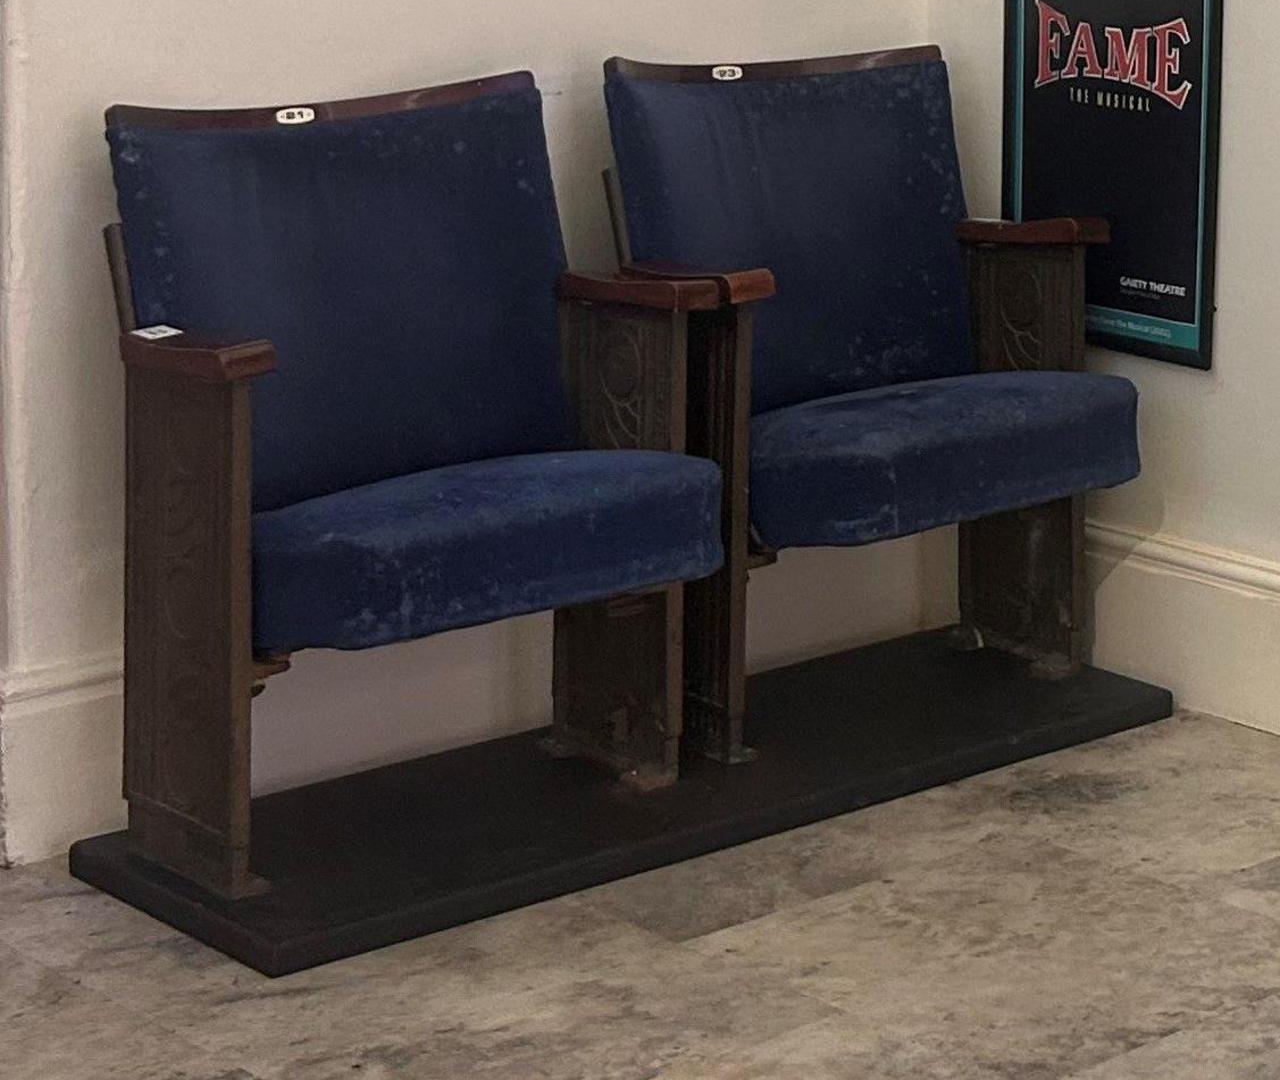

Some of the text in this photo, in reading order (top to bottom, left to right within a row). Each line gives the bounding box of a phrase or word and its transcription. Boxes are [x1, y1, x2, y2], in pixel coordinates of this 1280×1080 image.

[1069, 87, 1151, 112] THE MUSICAL
[1120, 276, 1186, 297] GAIETY THEATRE
